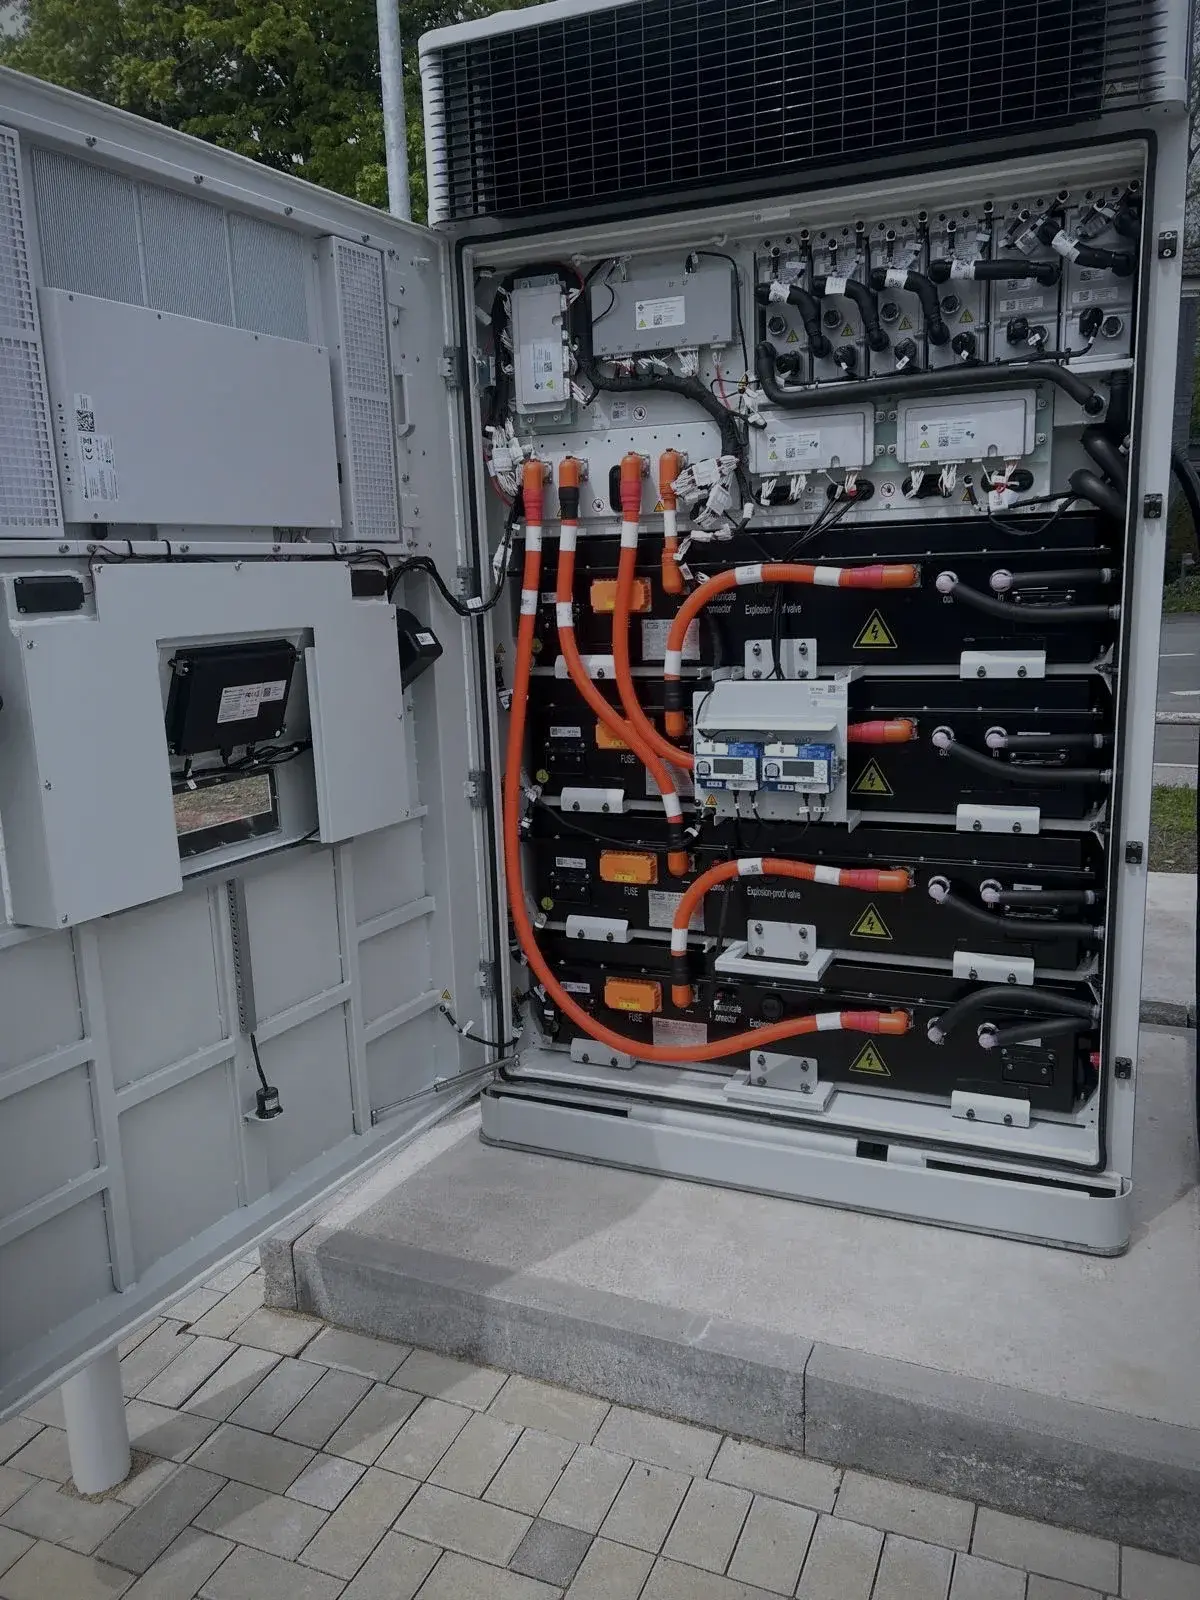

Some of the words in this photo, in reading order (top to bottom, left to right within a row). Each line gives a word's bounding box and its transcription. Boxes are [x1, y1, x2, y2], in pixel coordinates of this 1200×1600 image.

[786, 604, 802, 614] valve
[992, 749, 999, 757] In
[620, 754, 636, 764] FUSE
[624, 886, 638, 896] FUSE
[746, 885, 787, 899] Explosion-proof
[786, 888, 801, 899] valve
[628, 1012, 643, 1023] FUSE
[714, 1014, 737, 1024] onnector
